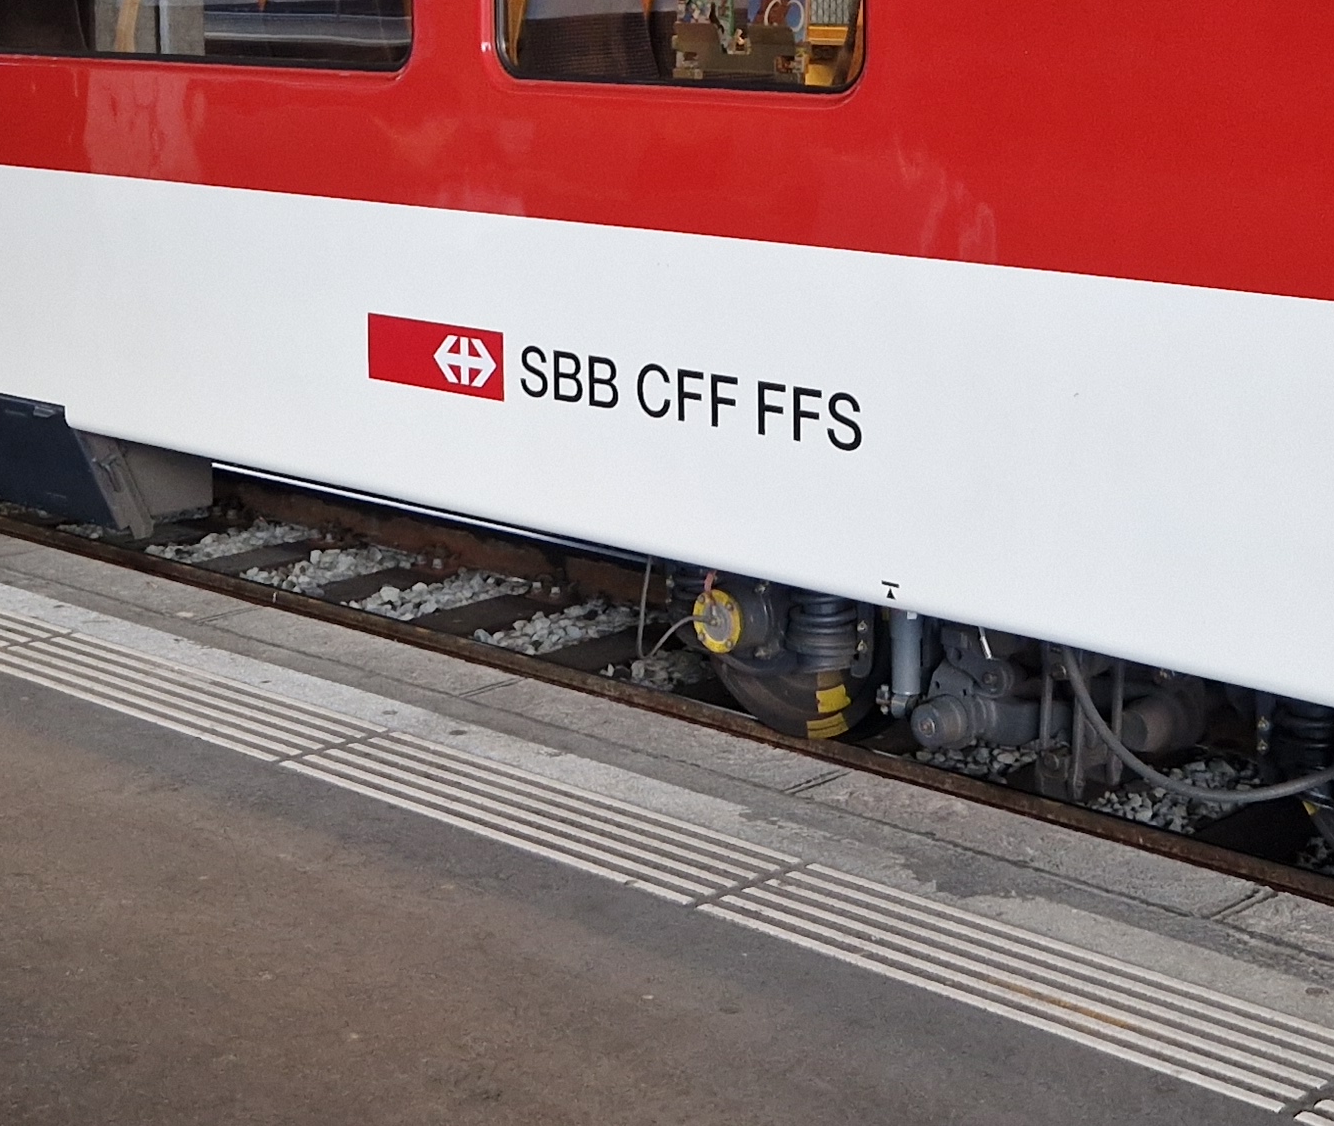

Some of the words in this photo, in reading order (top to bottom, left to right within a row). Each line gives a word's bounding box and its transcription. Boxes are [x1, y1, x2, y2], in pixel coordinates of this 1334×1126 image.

[520, 345, 619, 409] SBB
[636, 363, 739, 428] CFF
[757, 380, 864, 452] FFS
